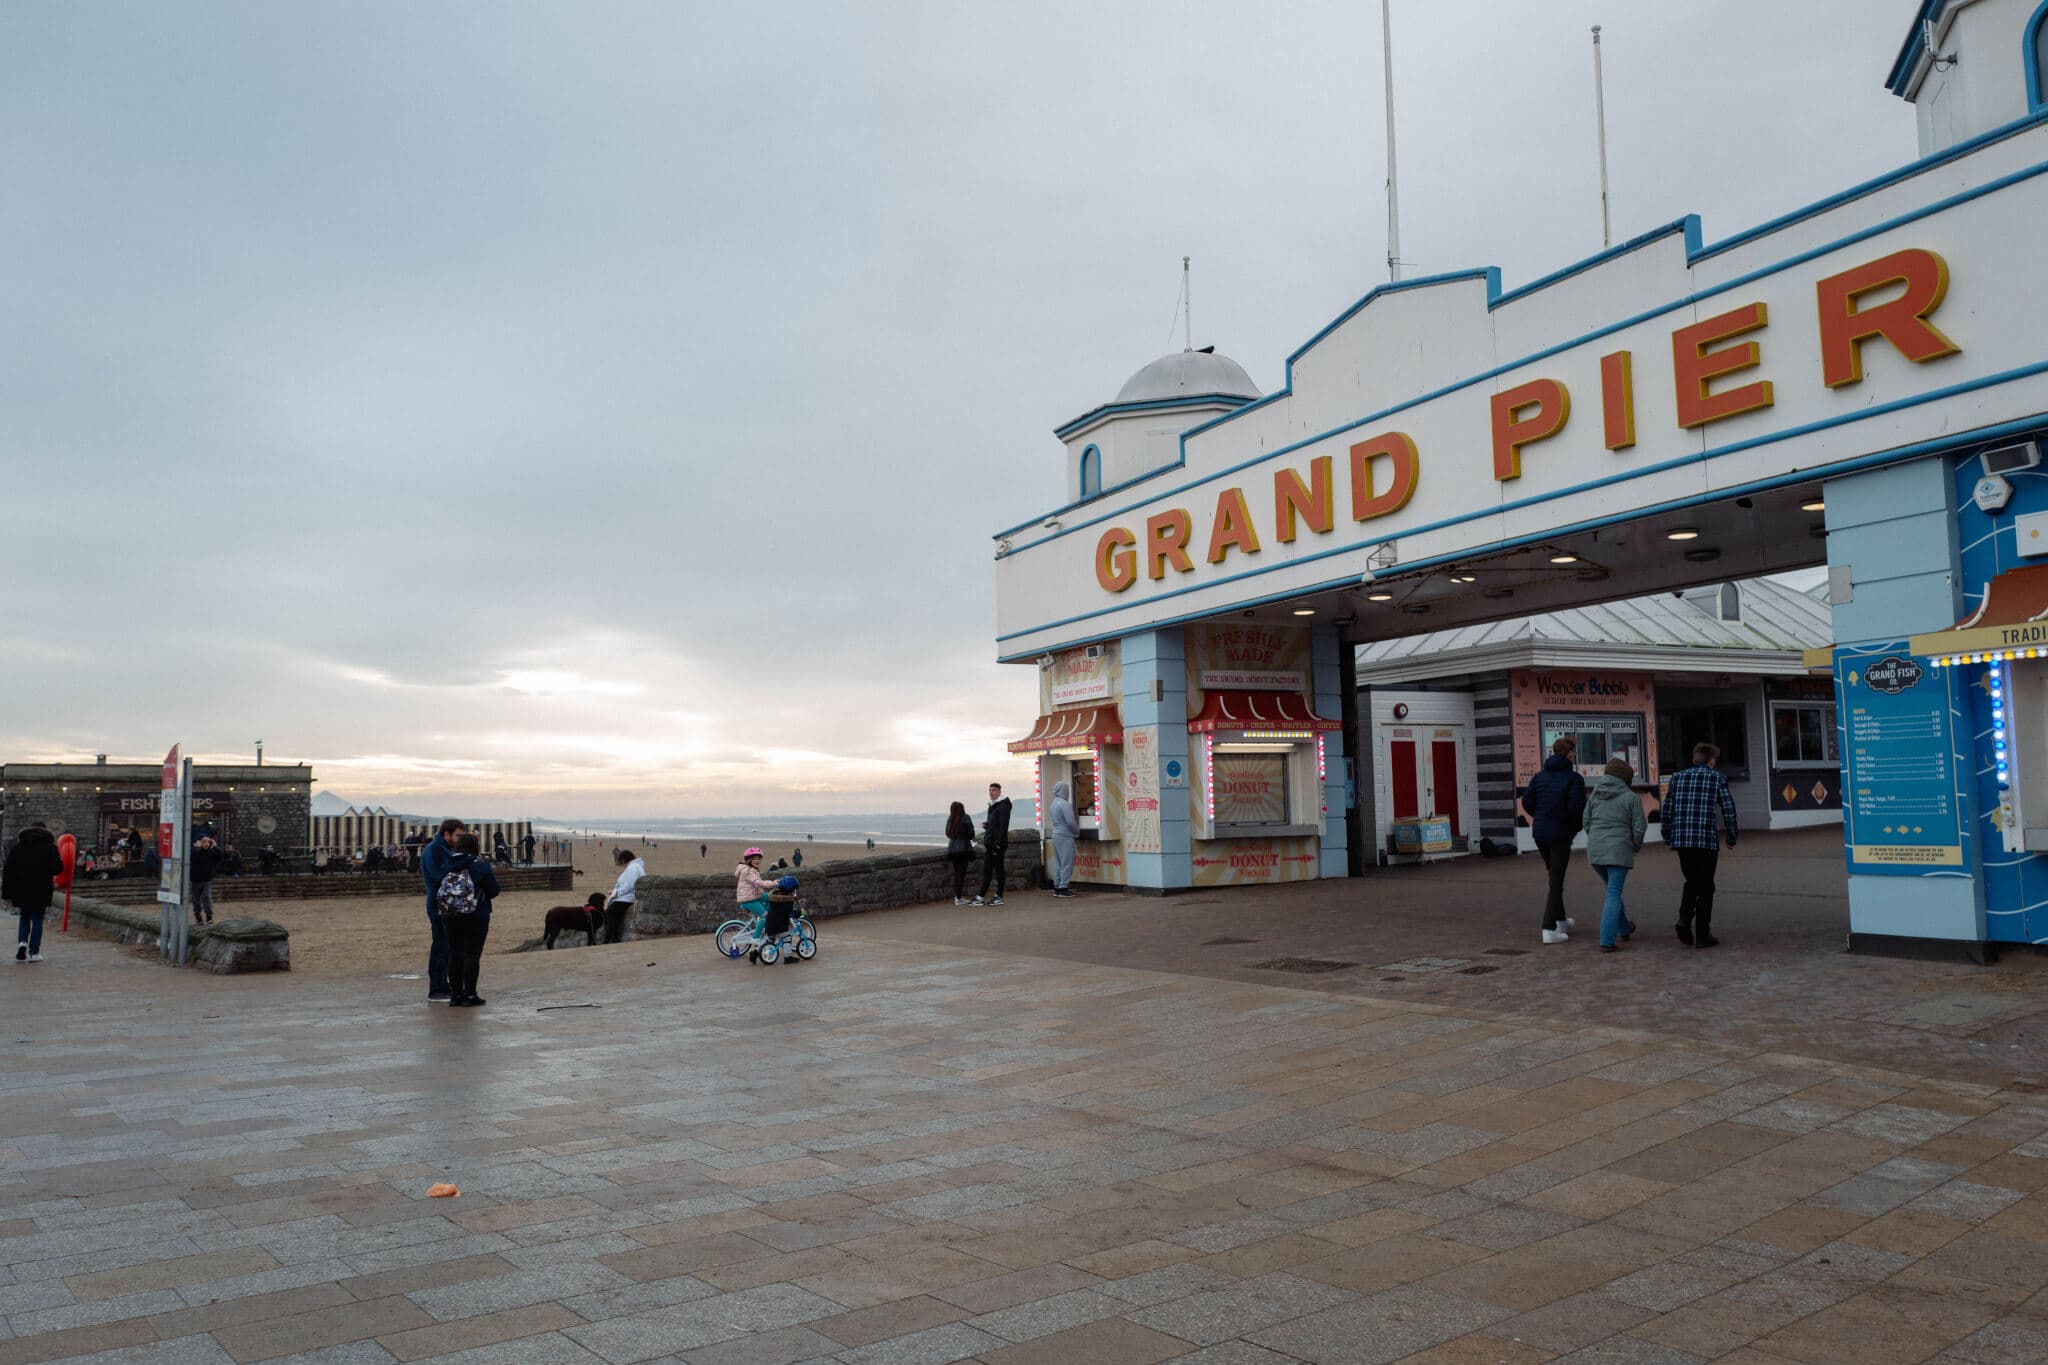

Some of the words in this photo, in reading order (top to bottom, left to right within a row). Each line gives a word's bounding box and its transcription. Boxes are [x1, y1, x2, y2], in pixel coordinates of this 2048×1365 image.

[1095, 430, 1421, 593] GRAND
[1490, 247, 1963, 481] PIER
[2001, 626, 2046, 645] TRADI
[1225, 648, 1274, 664] MADE
[1870, 669, 1896, 681] GRAND
[1897, 667, 1916, 678] FISH
[1536, 676, 1585, 695] Wonder
[1589, 676, 1629, 696] Bubble
[1217, 721, 1244, 729] DONUTS
[1545, 721, 1556, 729] BOX
[1556, 721, 1574, 729] OFFICE
[1585, 721, 1604, 729] OFFICE
[1223, 782, 1270, 794] DONUT
[120, 798, 153, 810] FISH
[1230, 854, 1279, 867] DONUT
